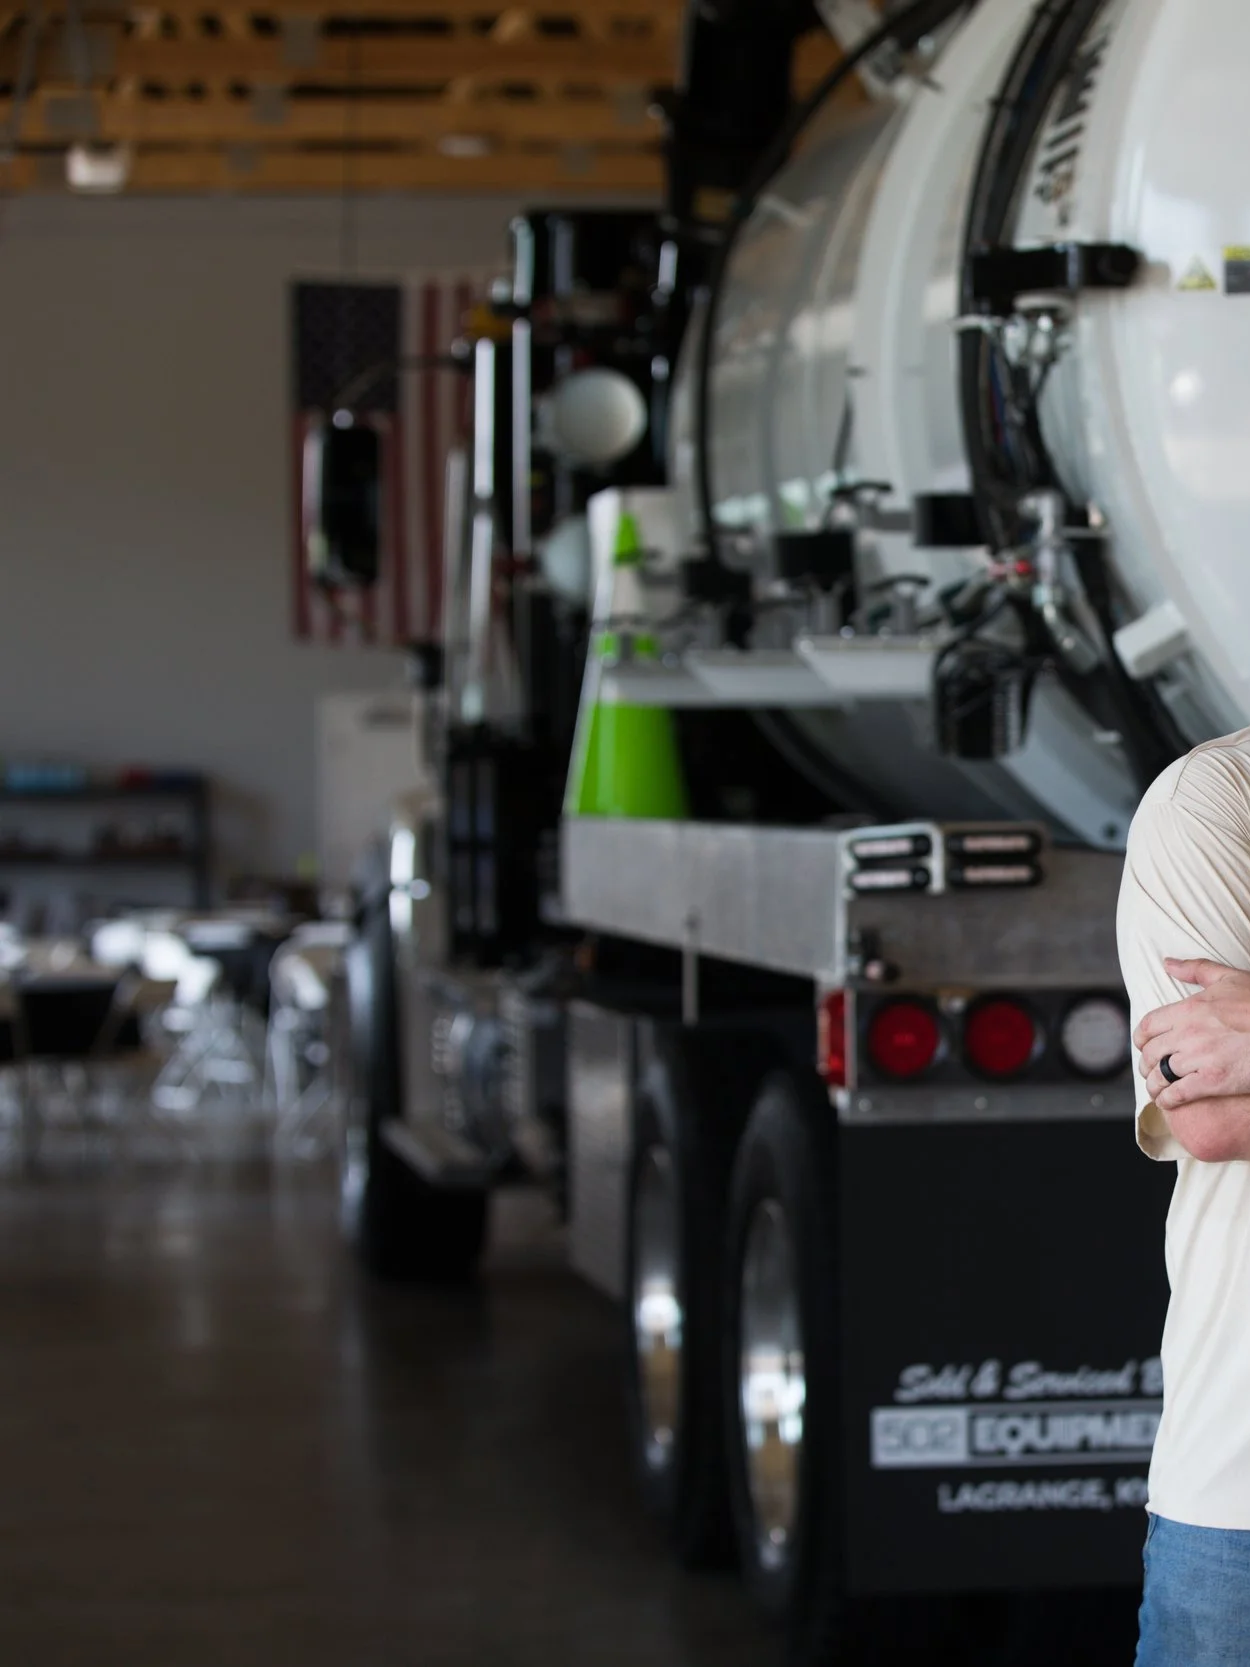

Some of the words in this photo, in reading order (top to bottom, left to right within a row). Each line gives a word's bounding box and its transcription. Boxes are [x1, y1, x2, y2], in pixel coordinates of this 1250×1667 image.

[894, 1363, 972, 1403] Sold
[970, 1358, 1001, 1398] &
[880, 1415, 958, 1454] 502
